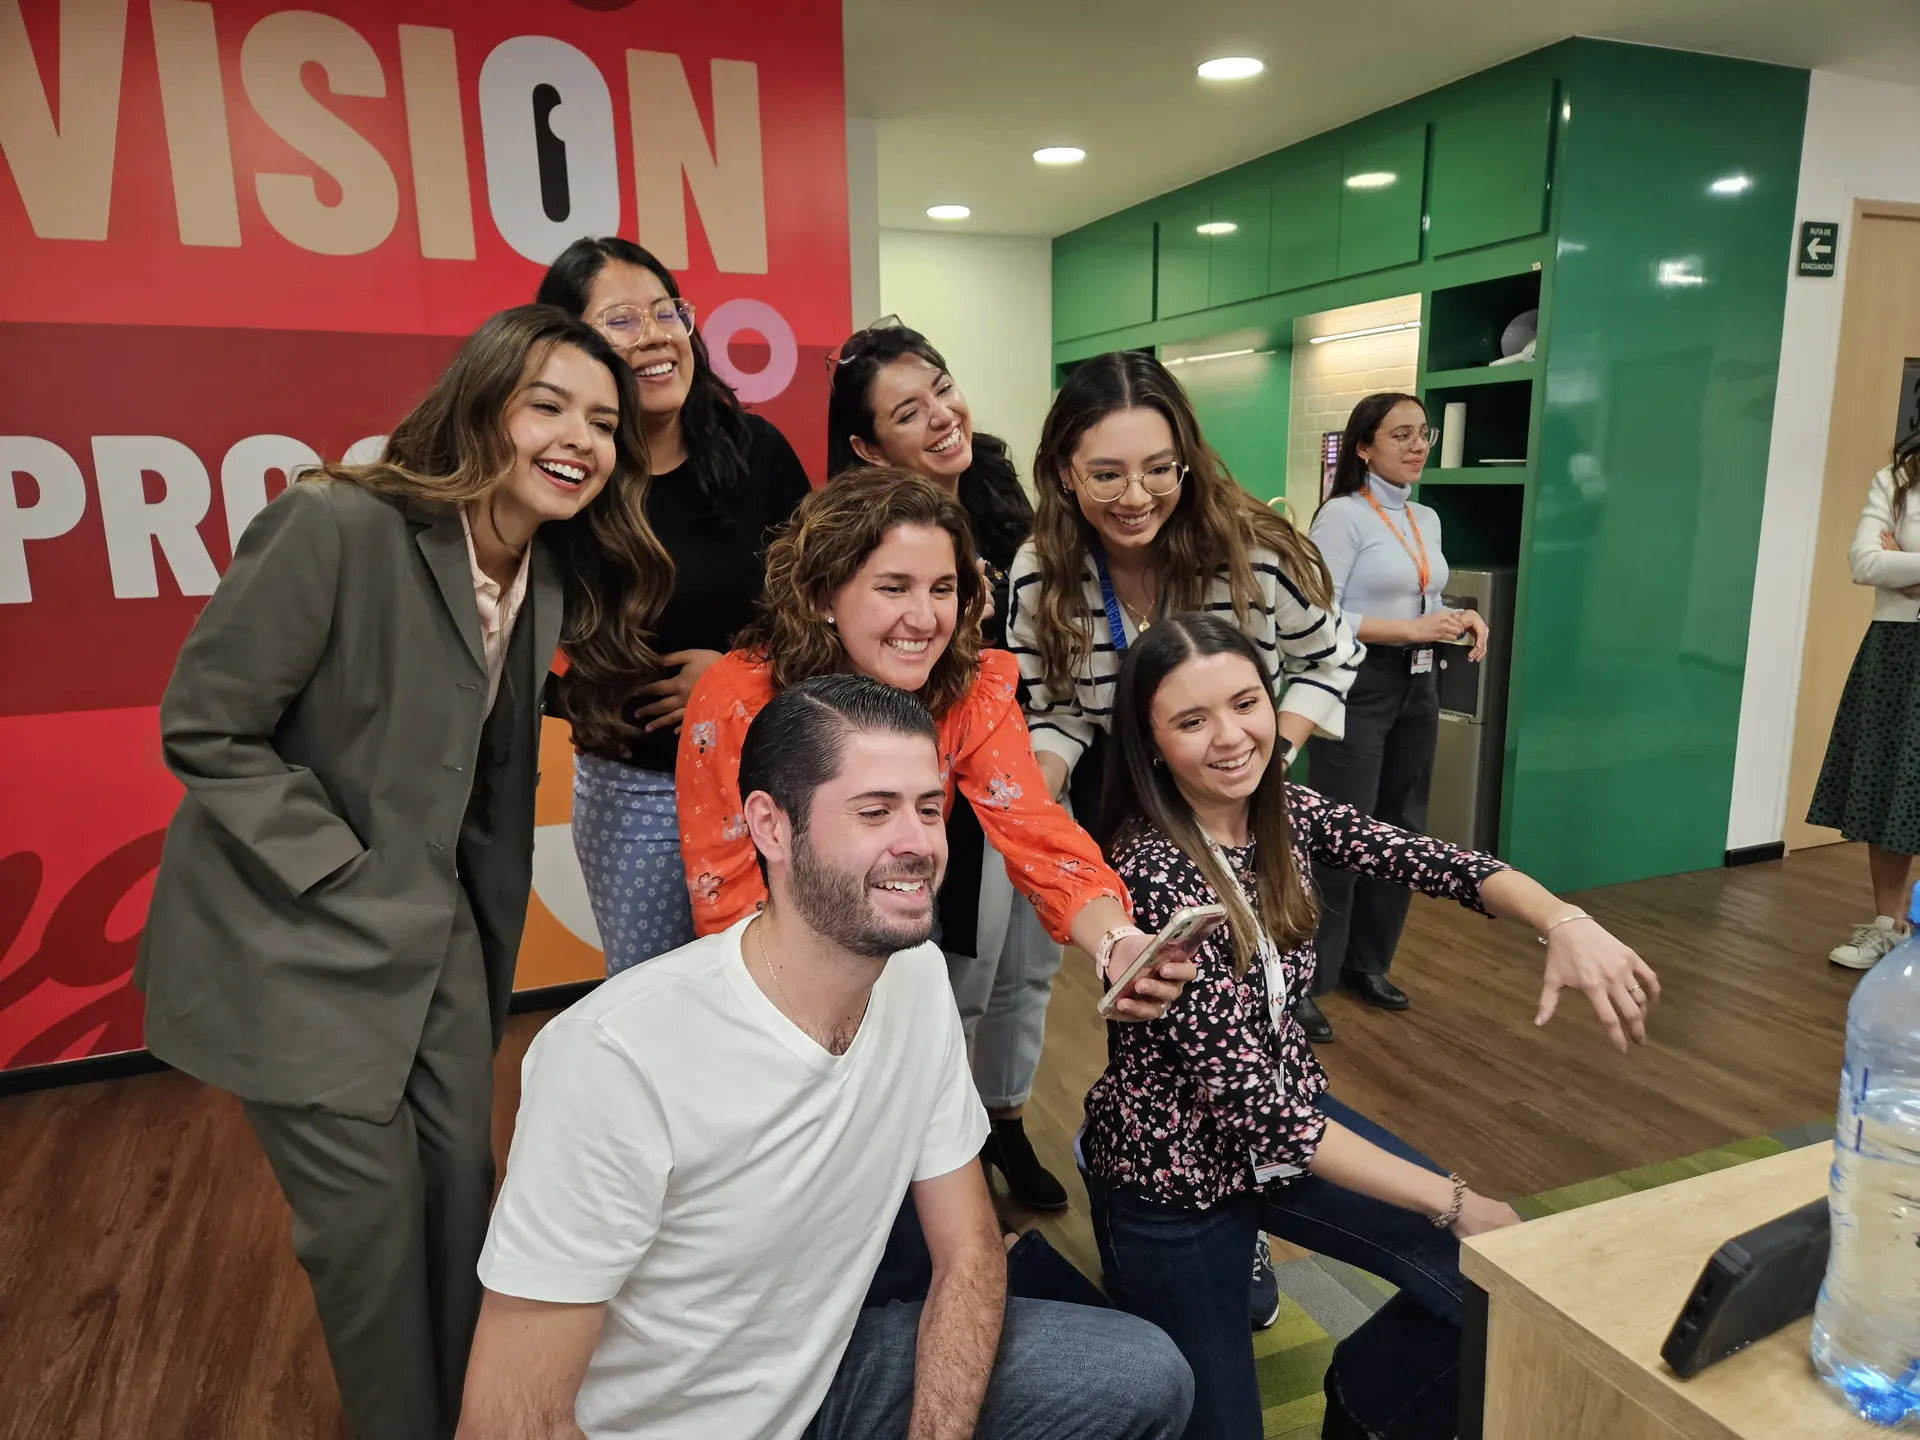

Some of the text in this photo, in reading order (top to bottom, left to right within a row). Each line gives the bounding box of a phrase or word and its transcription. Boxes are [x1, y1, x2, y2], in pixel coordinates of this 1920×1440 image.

[1809, 227, 1832, 236] RUTA DE
[1801, 262, 1833, 271] EVACUACIÓN
[0, 434, 390, 603] PRO
